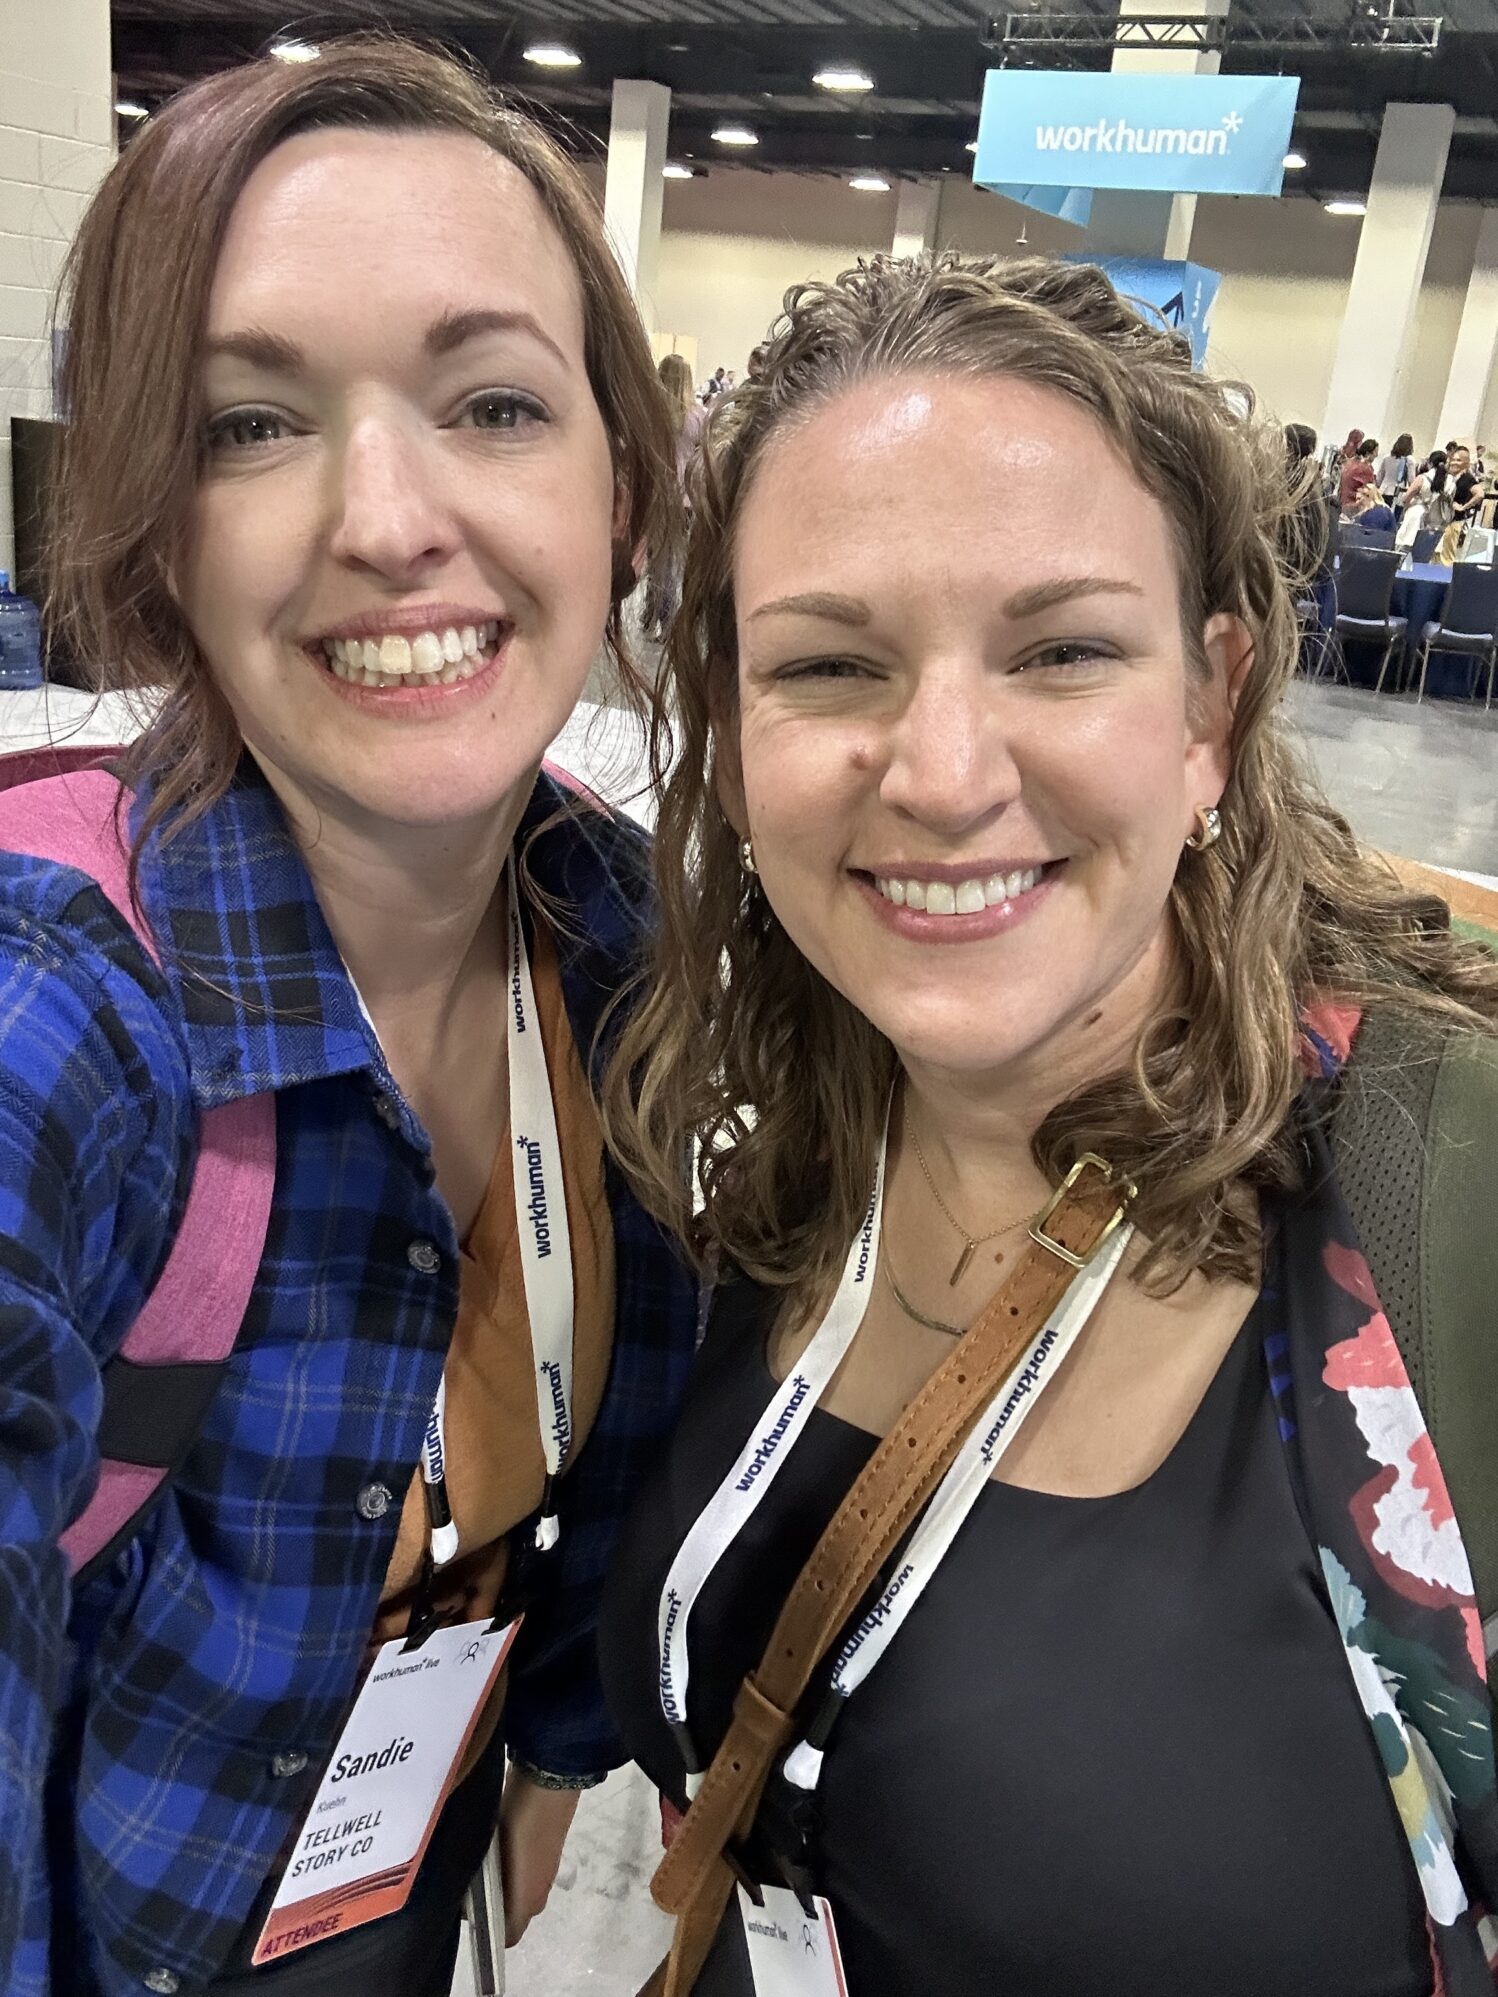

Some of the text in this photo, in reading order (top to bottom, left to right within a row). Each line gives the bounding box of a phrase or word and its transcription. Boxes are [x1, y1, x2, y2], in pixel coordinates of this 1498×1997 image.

[331, 1737, 415, 1783] Sandie
[303, 1810, 381, 1850] TELLWELL
[292, 1836, 374, 1878] STORY CO
[261, 1913, 341, 1955] ATTENDEE
